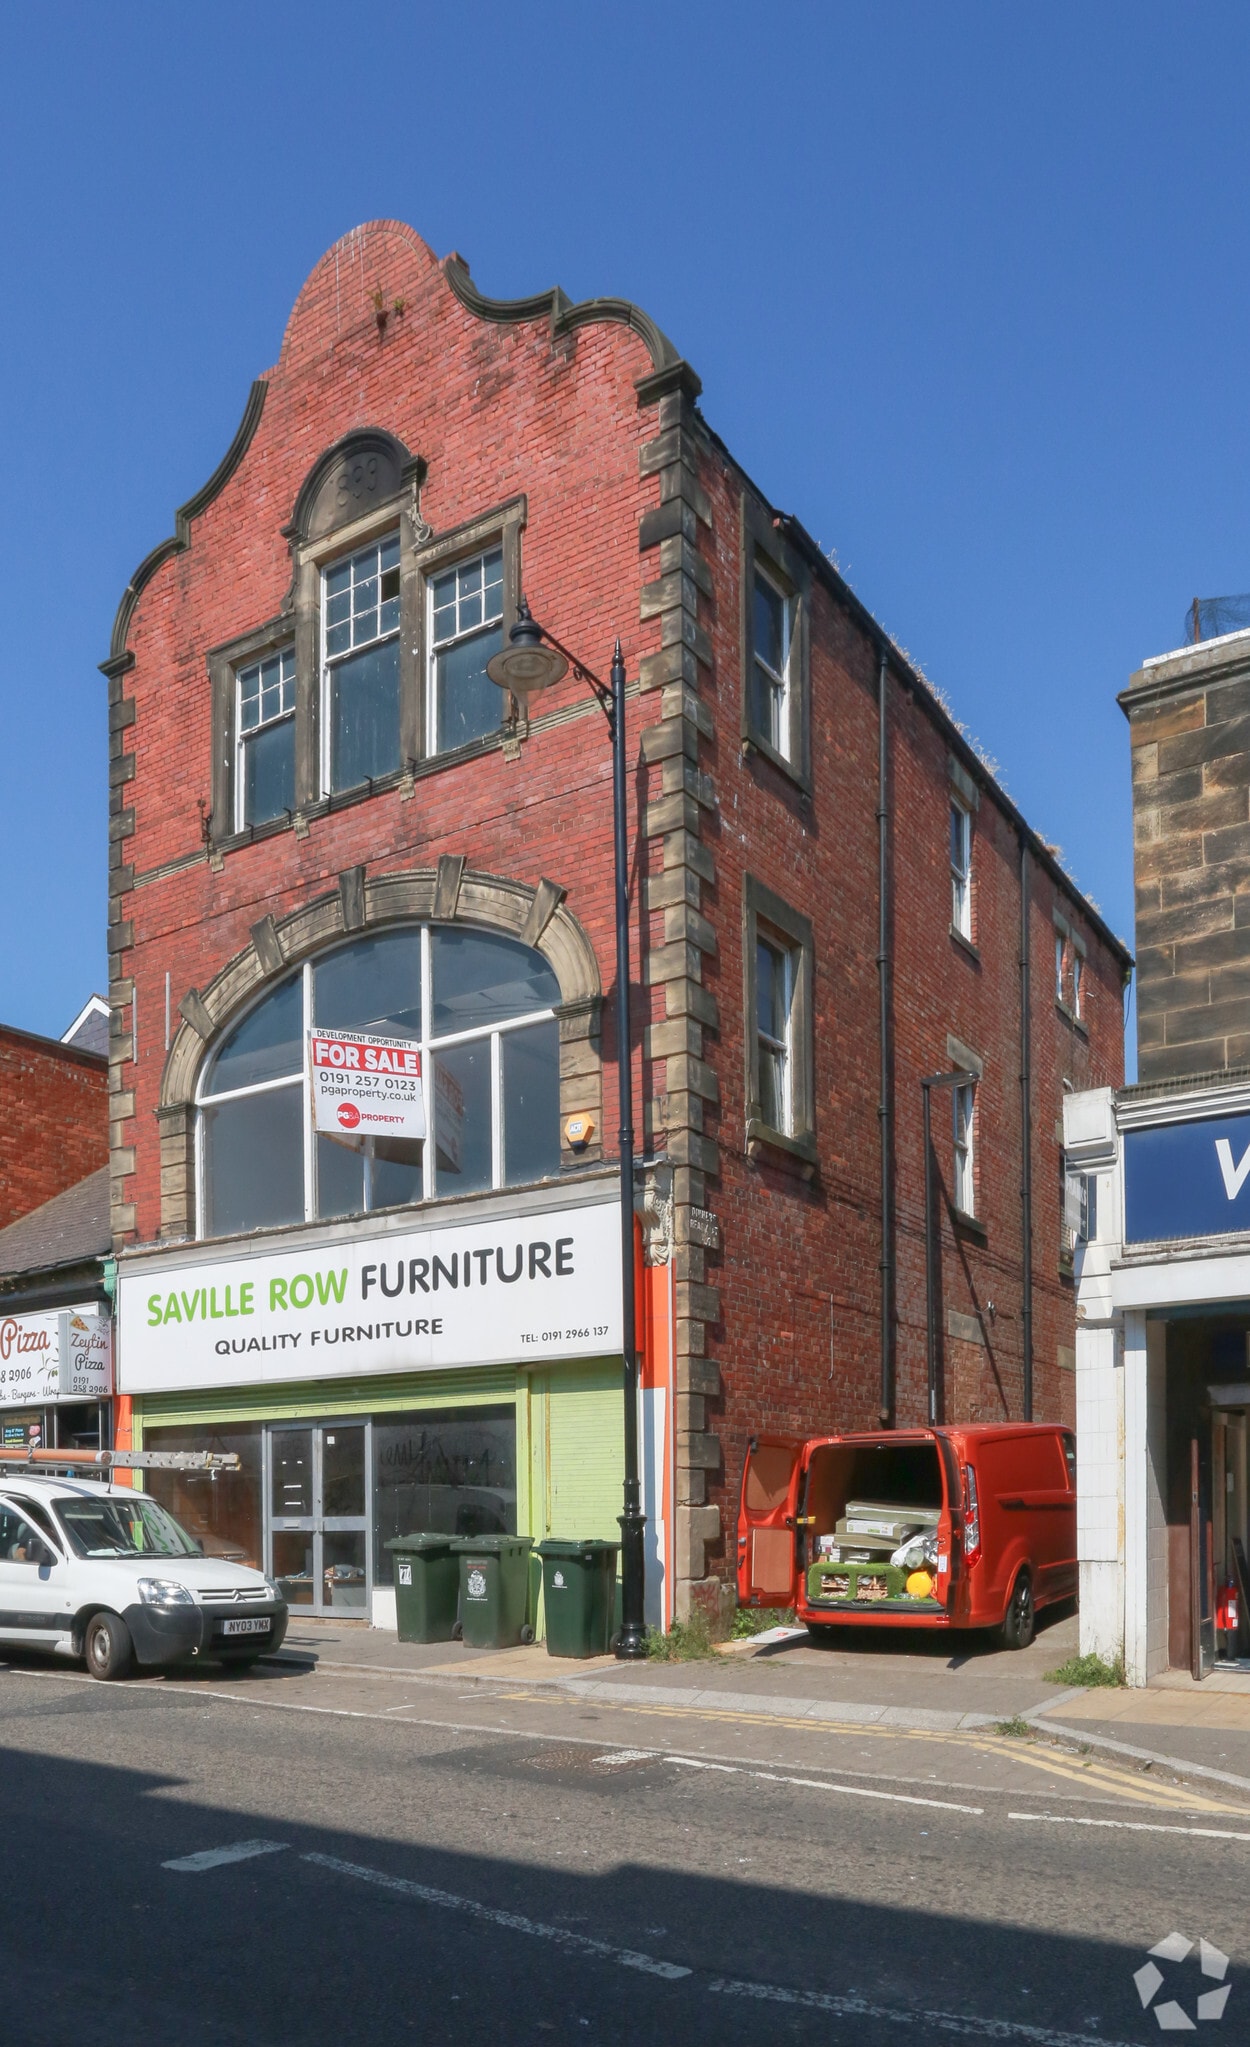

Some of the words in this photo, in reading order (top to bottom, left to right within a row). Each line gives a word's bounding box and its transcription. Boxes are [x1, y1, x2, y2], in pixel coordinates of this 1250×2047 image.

[317, 1030, 366, 1043] DEVELOPMENT
[368, 1036, 411, 1049] OPPORTUNITY
[316, 1042, 360, 1068] FOR
[365, 1049, 418, 1075] SALE
[320, 1072, 350, 1084] 0191
[356, 1075, 379, 1088] 257
[385, 1079, 416, 1091] 0123
[321, 1085, 416, 1102] pgaproperty.co.uk
[361, 1113, 405, 1123] PROPERTY
[147, 1282, 255, 1327] SAVILLE
[269, 1268, 348, 1312] ROW
[361, 1237, 575, 1300] FURNITURE
[0, 1318, 50, 1360] Pizza
[214, 1333, 302, 1355] QUALITY
[311, 1318, 443, 1346] FURNITURE
[521, 1334, 539, 1343] TEL:
[541, 1330, 562, 1342] 0191
[565, 1328, 590, 1339] 2966
[593, 1325, 609, 1336] 137
[71, 1333, 109, 1355] Zeytin
[75, 1353, 105, 1371] Pizza
[9, 1366, 31, 1382] 2906
[73, 1376, 89, 1384] 0191
[73, 1384, 87, 1393] 258
[89, 1385, 108, 1394] 2906
